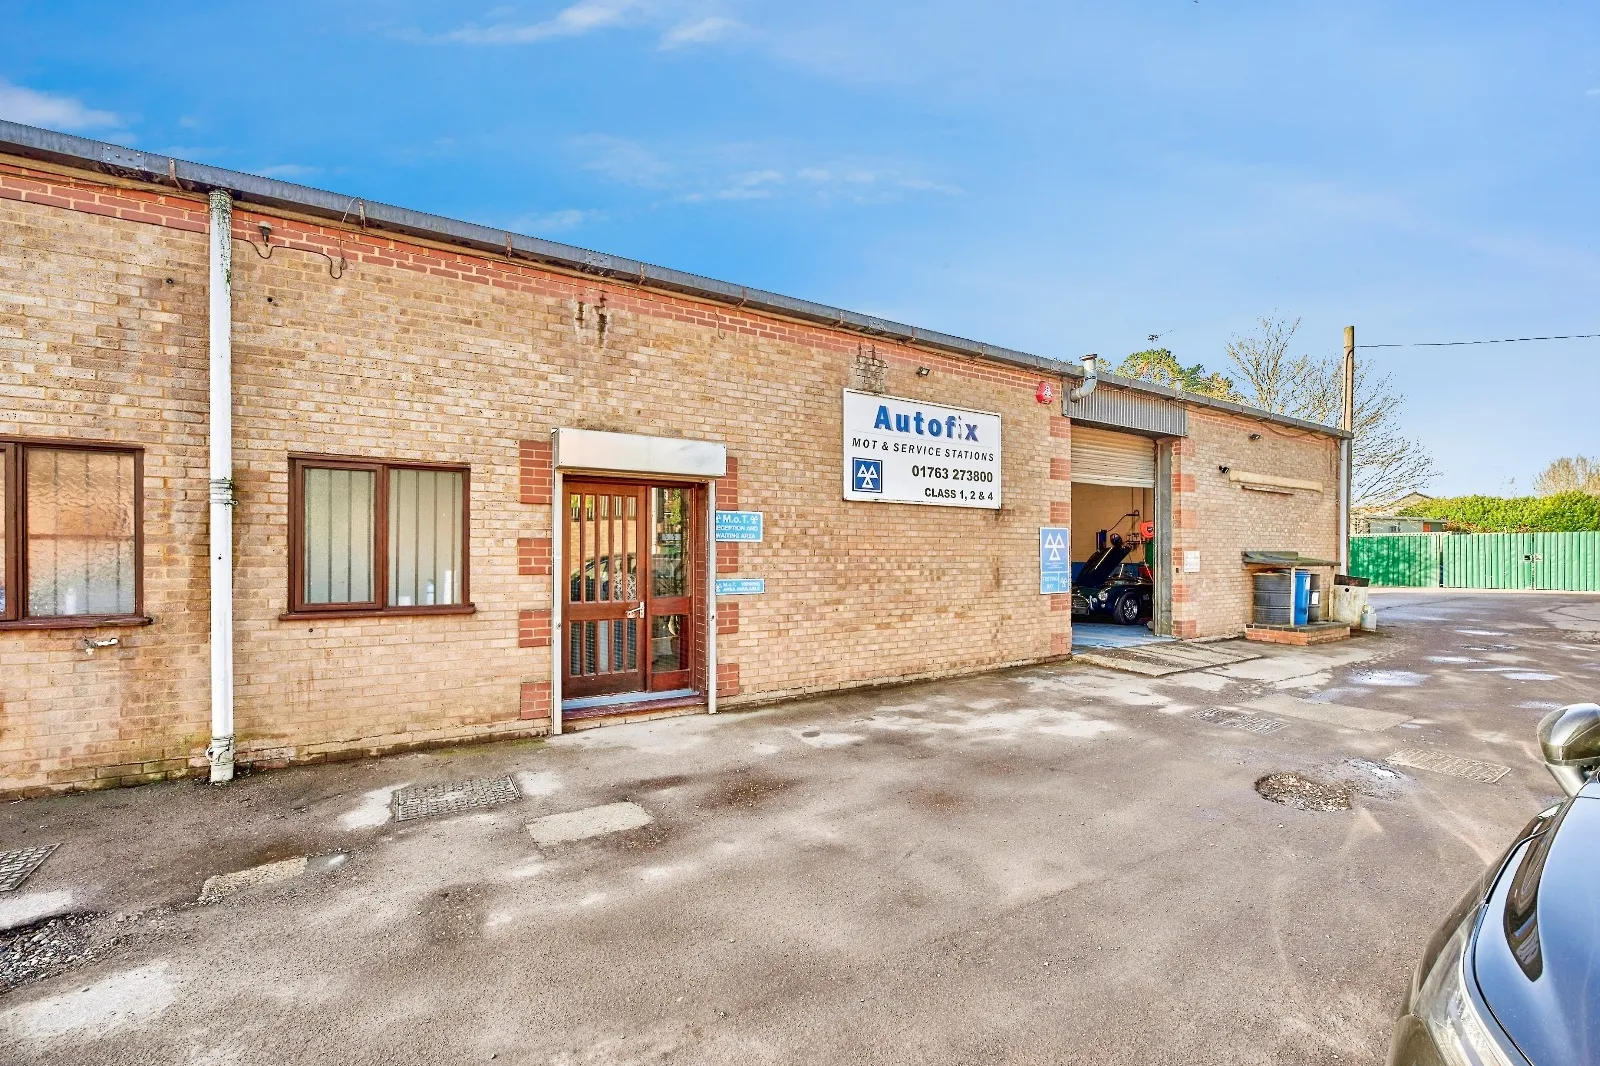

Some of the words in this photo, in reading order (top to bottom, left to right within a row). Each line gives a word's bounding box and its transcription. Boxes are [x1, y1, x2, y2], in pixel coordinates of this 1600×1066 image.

[874, 405, 979, 441] Autofix
[852, 437, 877, 449] MOT
[882, 441, 889, 451] &
[893, 442, 941, 456] SERVICE
[944, 448, 994, 462] STATIONS
[911, 464, 949, 480] 01763
[952, 468, 993, 483] 273800
[924, 487, 957, 499] CLASS
[959, 490, 968, 501] 1,
[970, 490, 976, 500] 2
[978, 491, 985, 501] &
[987, 491, 994, 501] 4
[722, 514, 749, 523] M.o.T.
